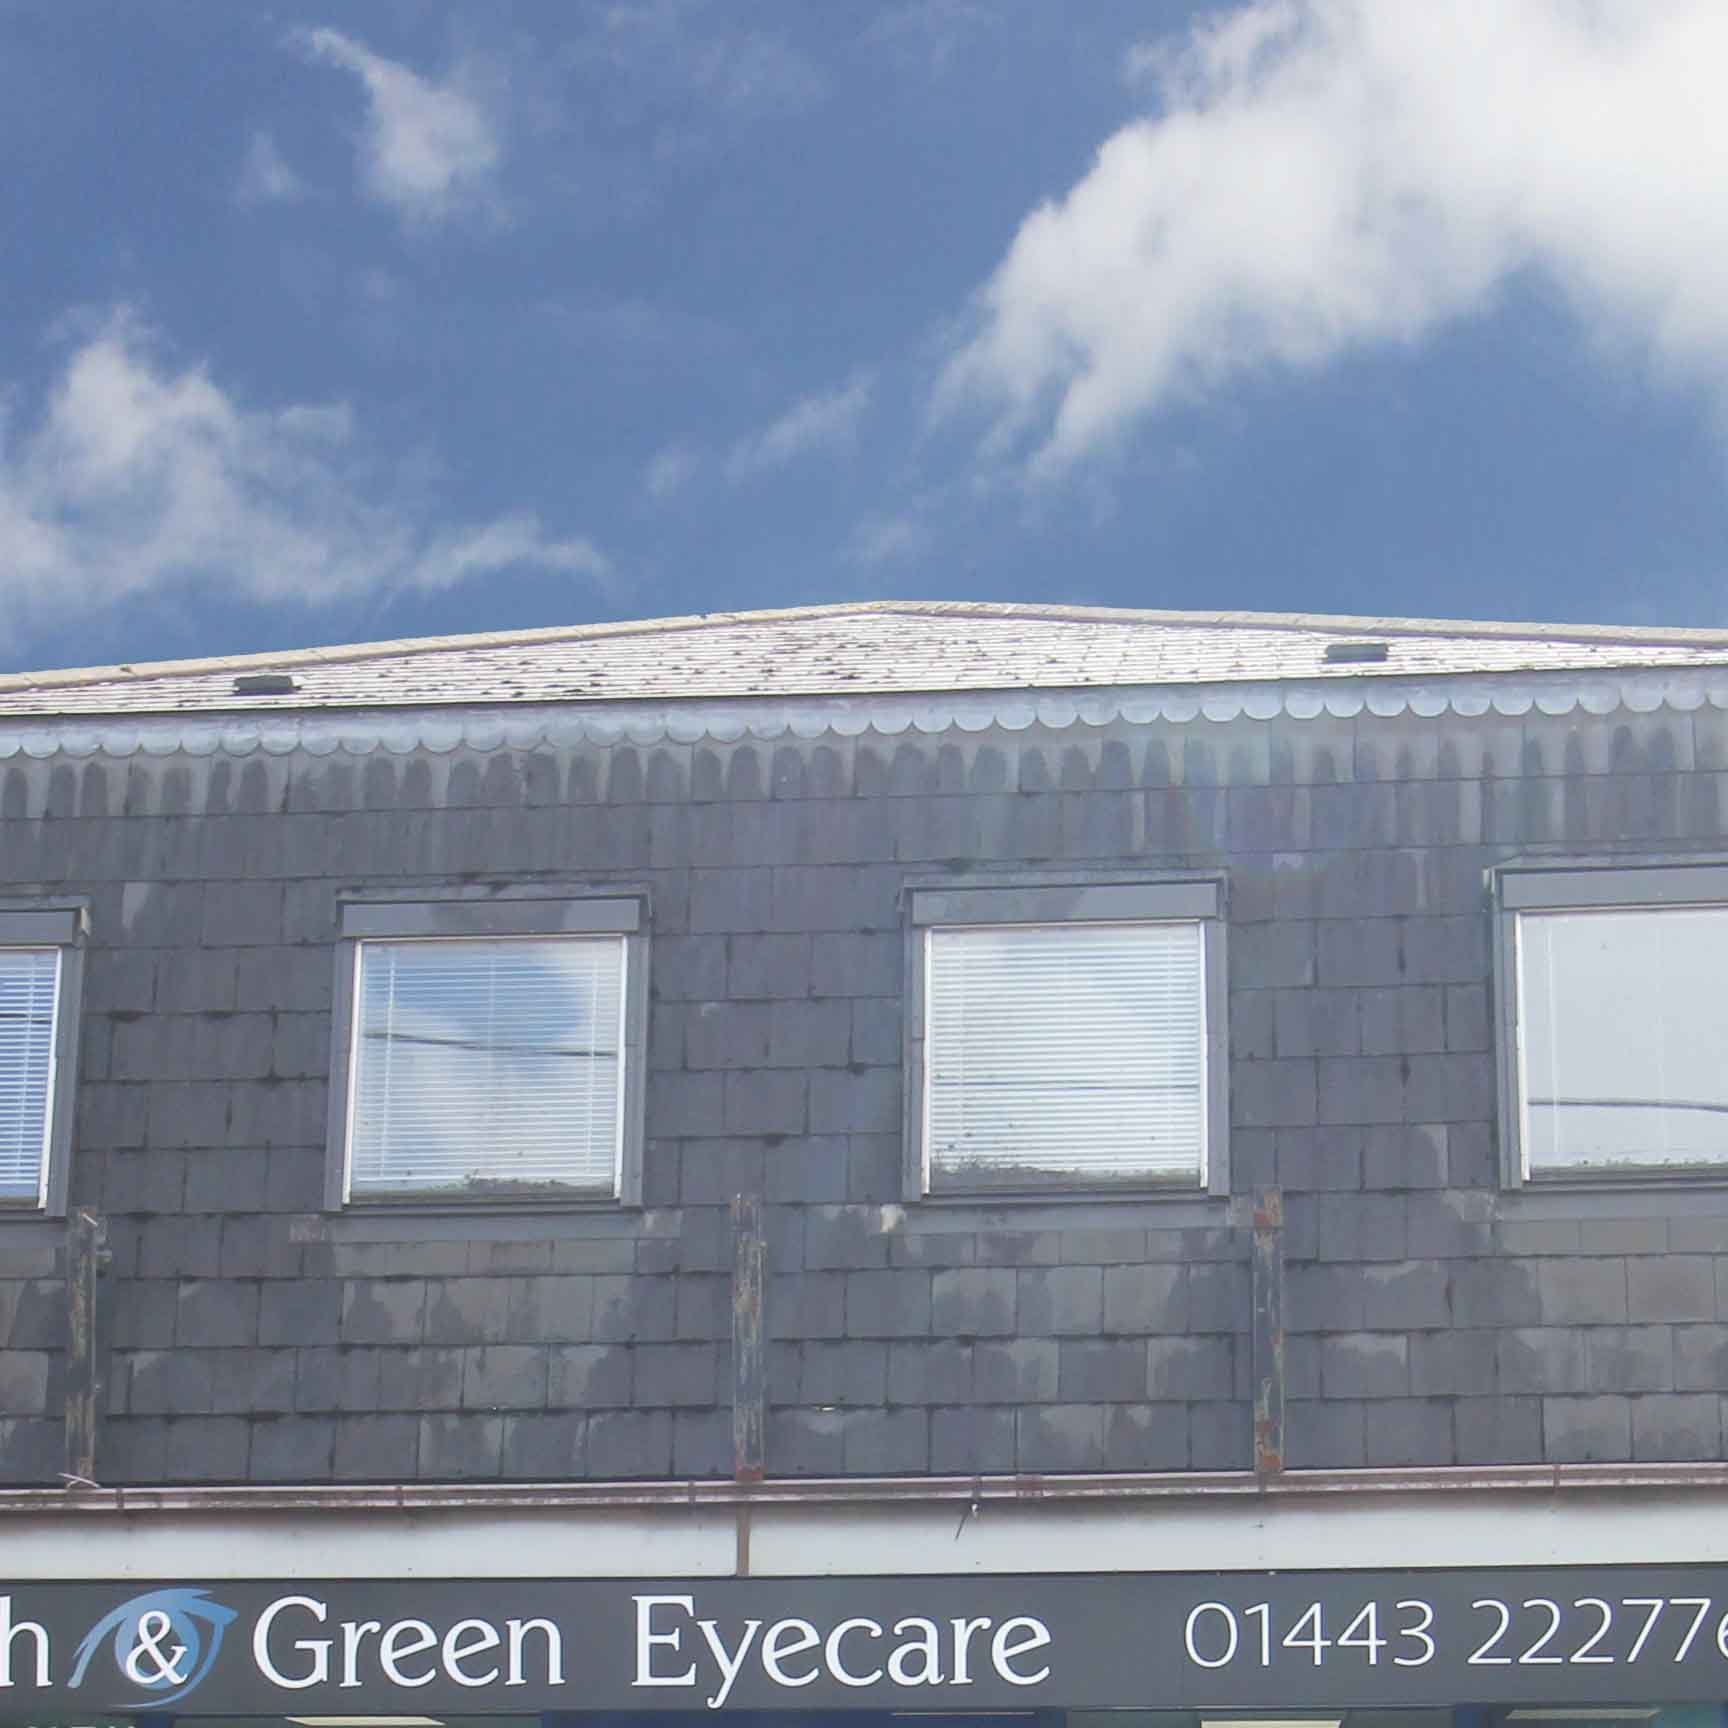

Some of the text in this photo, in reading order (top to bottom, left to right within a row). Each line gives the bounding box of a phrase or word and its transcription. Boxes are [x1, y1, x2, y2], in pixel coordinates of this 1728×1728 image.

[124, 1608, 189, 1687] &
[253, 1594, 565, 1690] Green
[631, 1594, 1051, 1709] Eyecare
[1183, 1600, 1435, 1668] 01443
